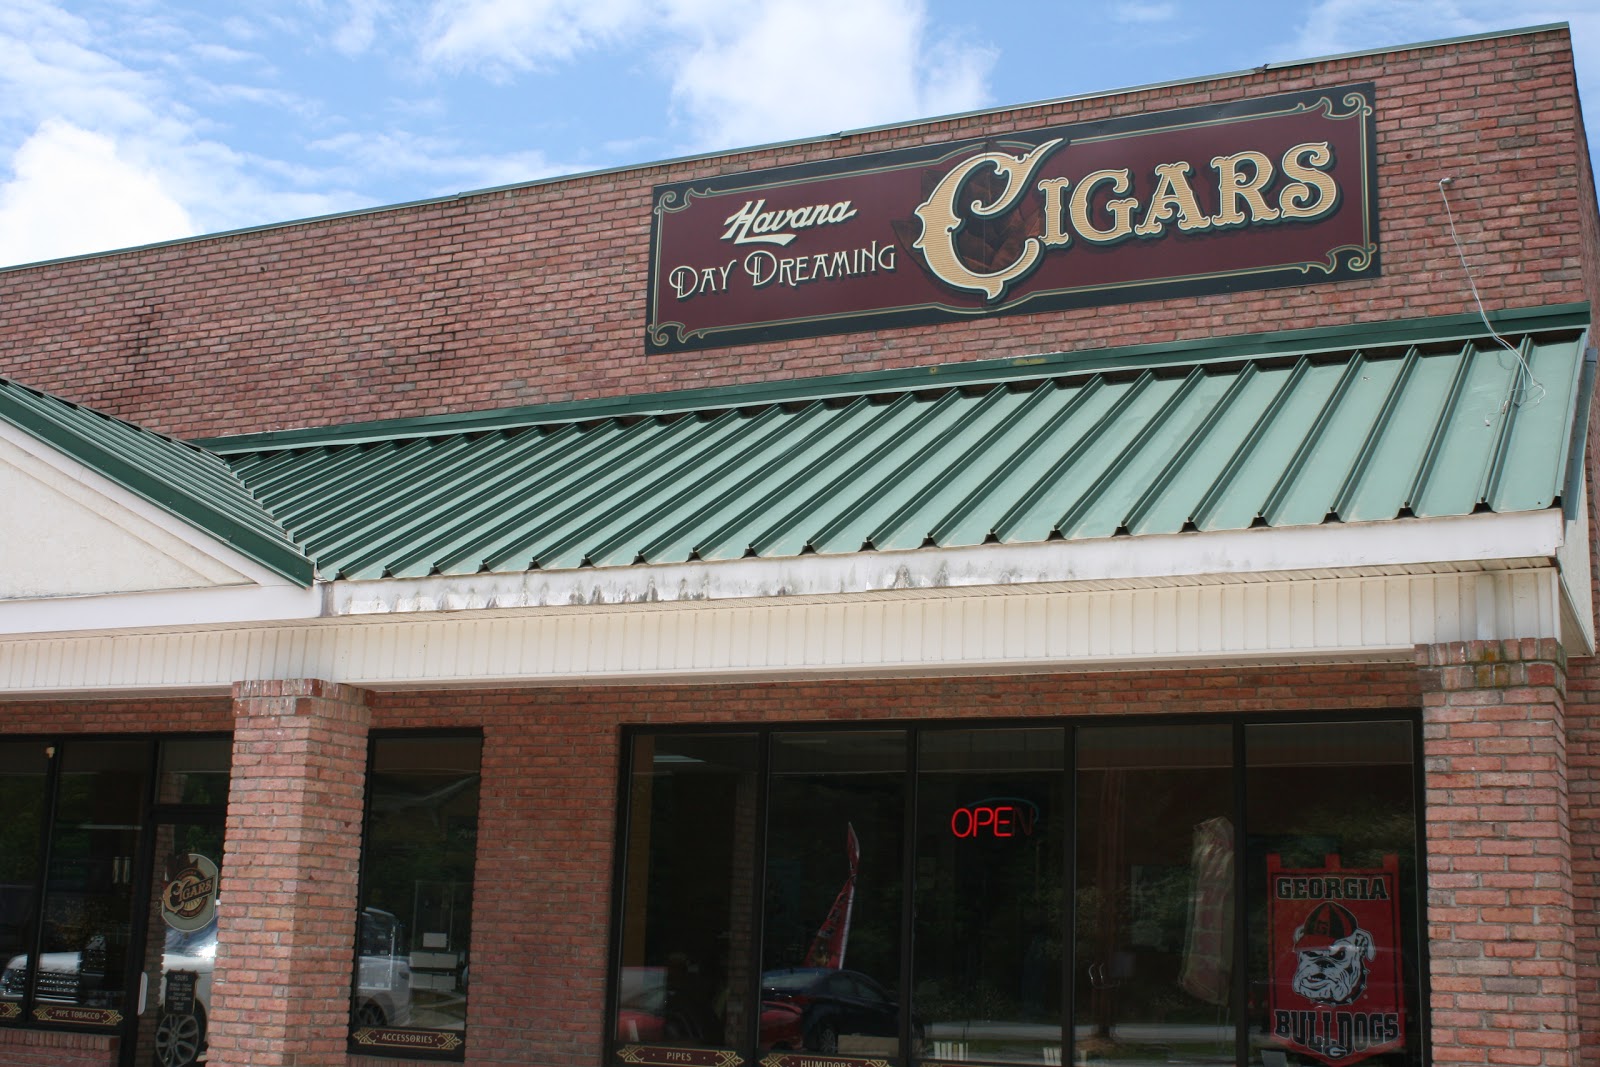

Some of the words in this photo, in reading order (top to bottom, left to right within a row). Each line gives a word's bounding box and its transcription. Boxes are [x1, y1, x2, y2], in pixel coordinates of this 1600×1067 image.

[720, 199, 858, 246] Havana
[912, 137, 1338, 299] CIGARS
[669, 259, 737, 299] DAY
[744, 240, 896, 287] DREAMING
[163, 879, 213, 914] CIGARS
[1276, 876, 1388, 900] GEORGIA
[55, 1009, 69, 1018] PIPE
[71, 1010, 100, 1020] TOBACCO
[381, 1032, 433, 1044] ACCESSORIES
[1274, 1009, 1399, 1055] BULLDOGS
[666, 1051, 692, 1061] PIPES
[800, 1059, 853, 1067] HUMIDORS
